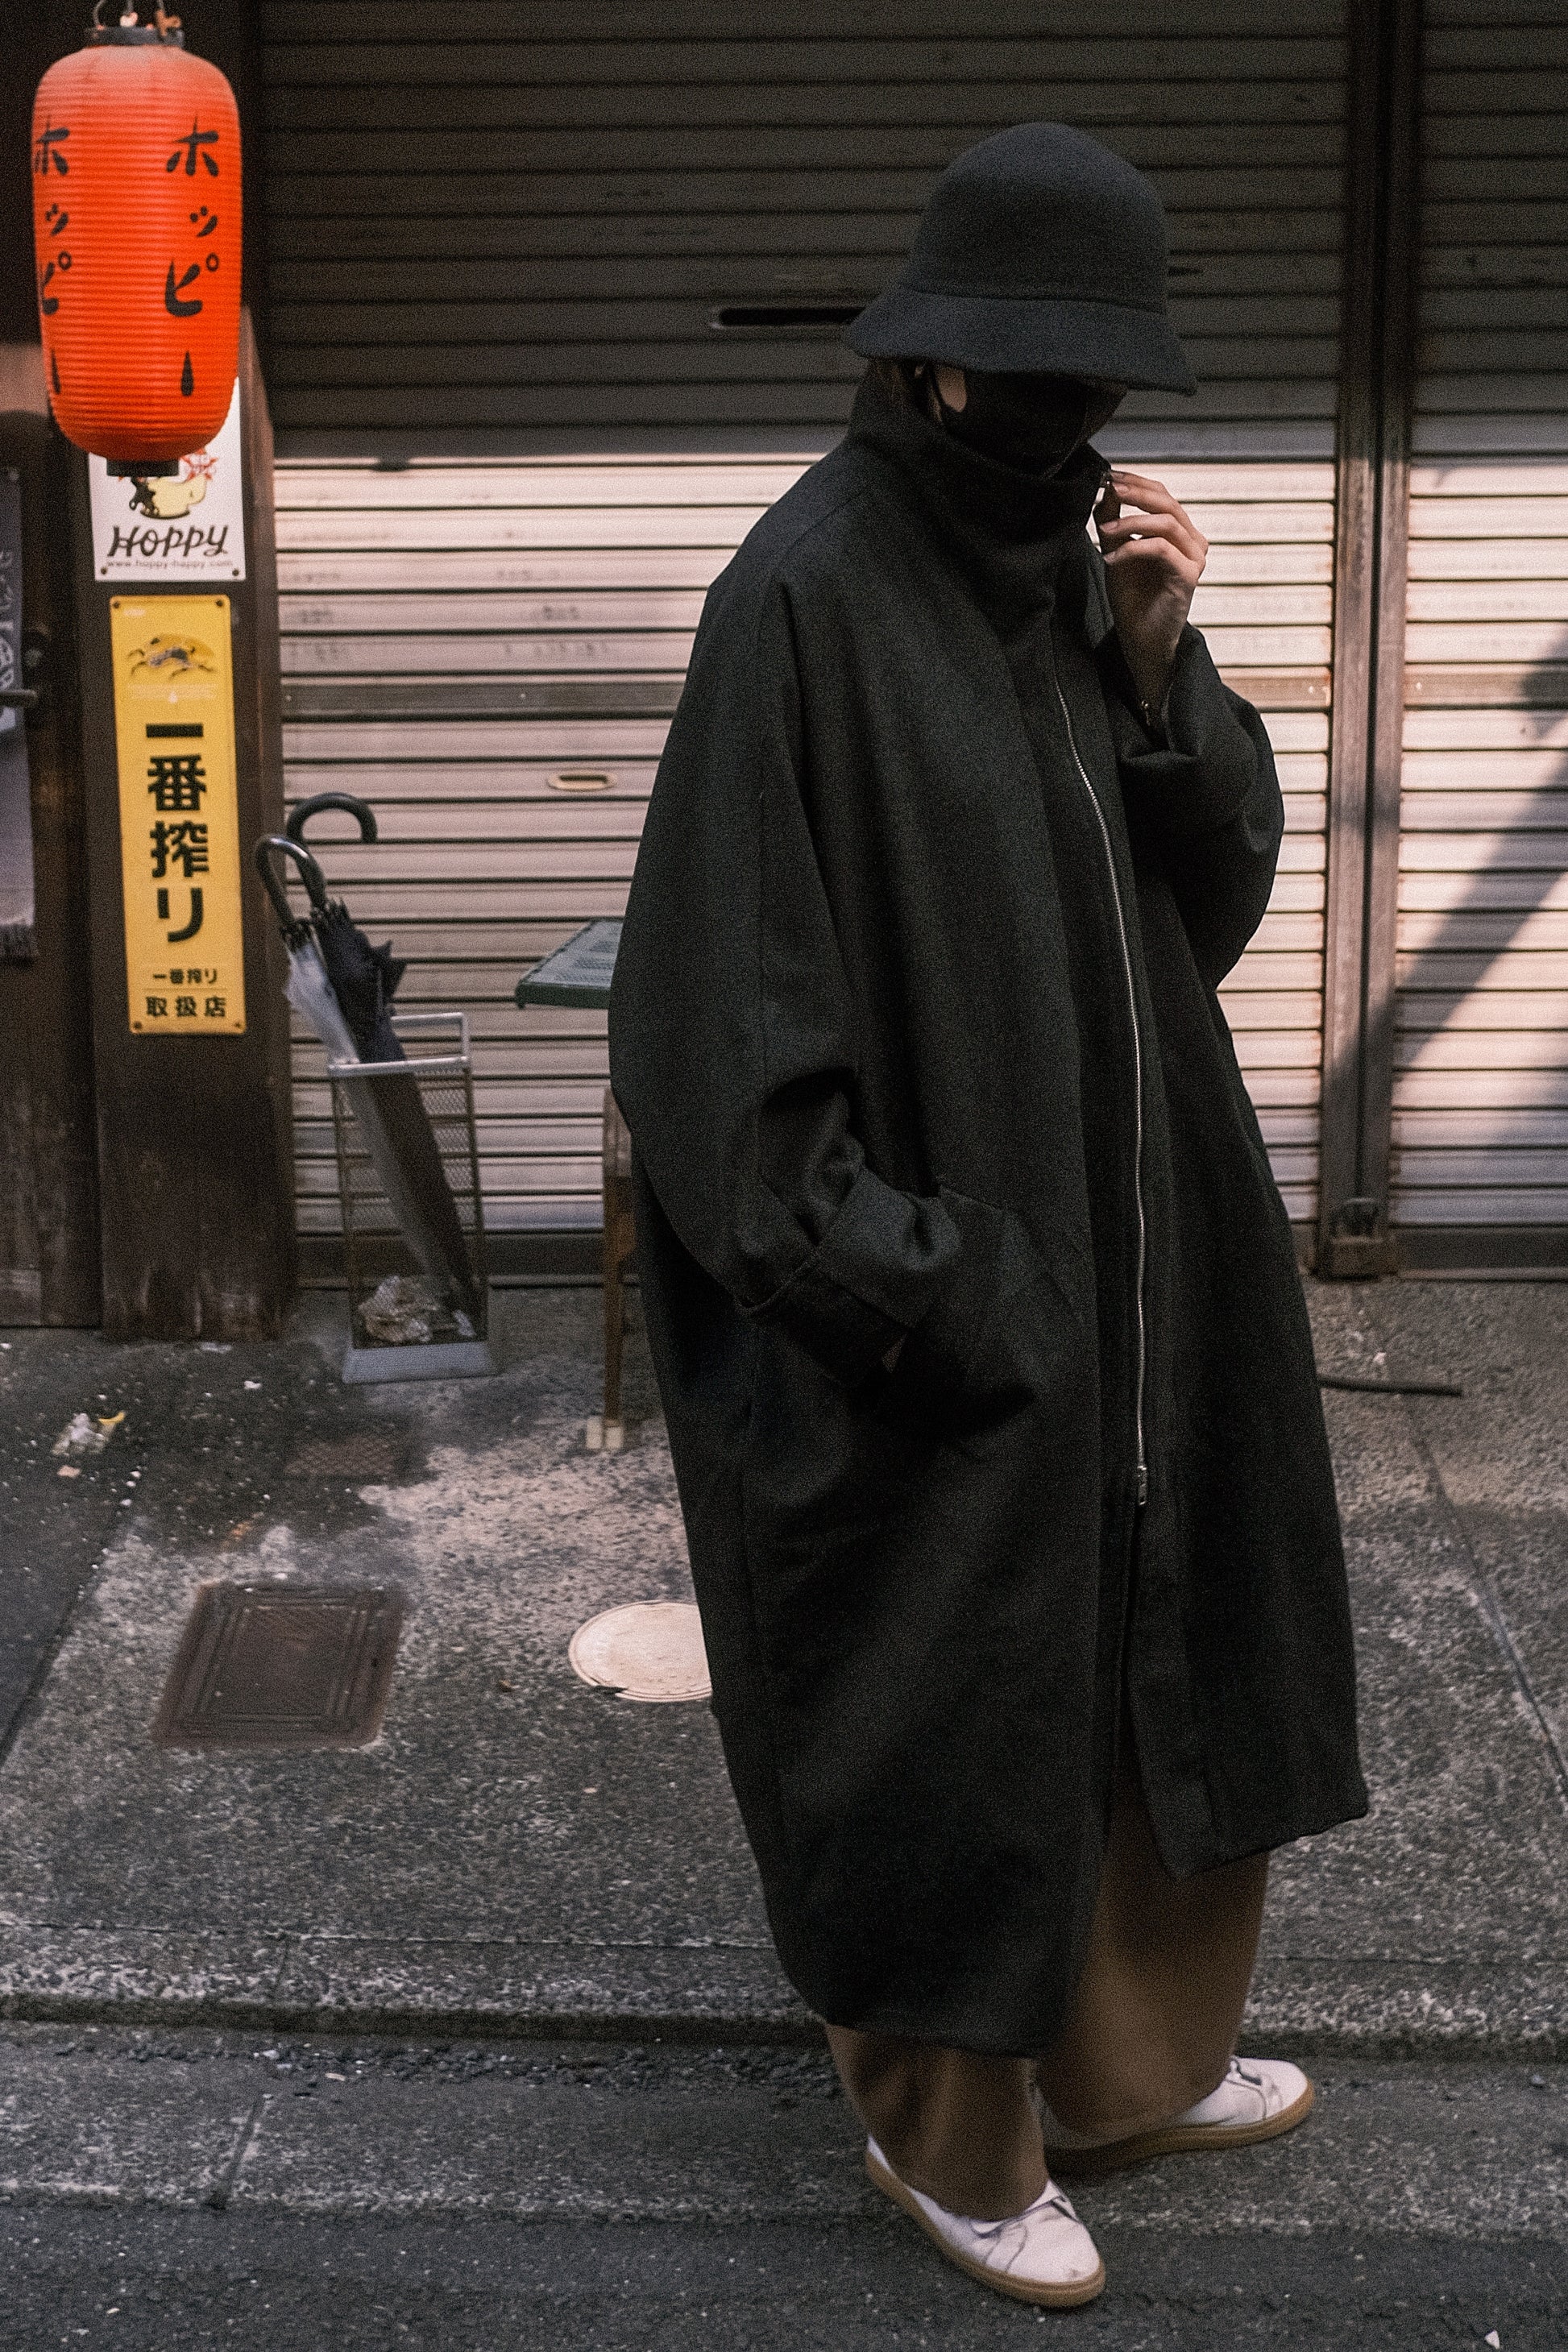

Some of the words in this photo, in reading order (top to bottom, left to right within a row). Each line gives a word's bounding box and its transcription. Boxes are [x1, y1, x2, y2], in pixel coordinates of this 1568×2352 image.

[165, 115, 219, 397] ホッピー
[146, 723, 209, 943] 一番搾り
[146, 996, 226, 1017] 取扱店
[152, 969, 218, 984] 一番搾り
